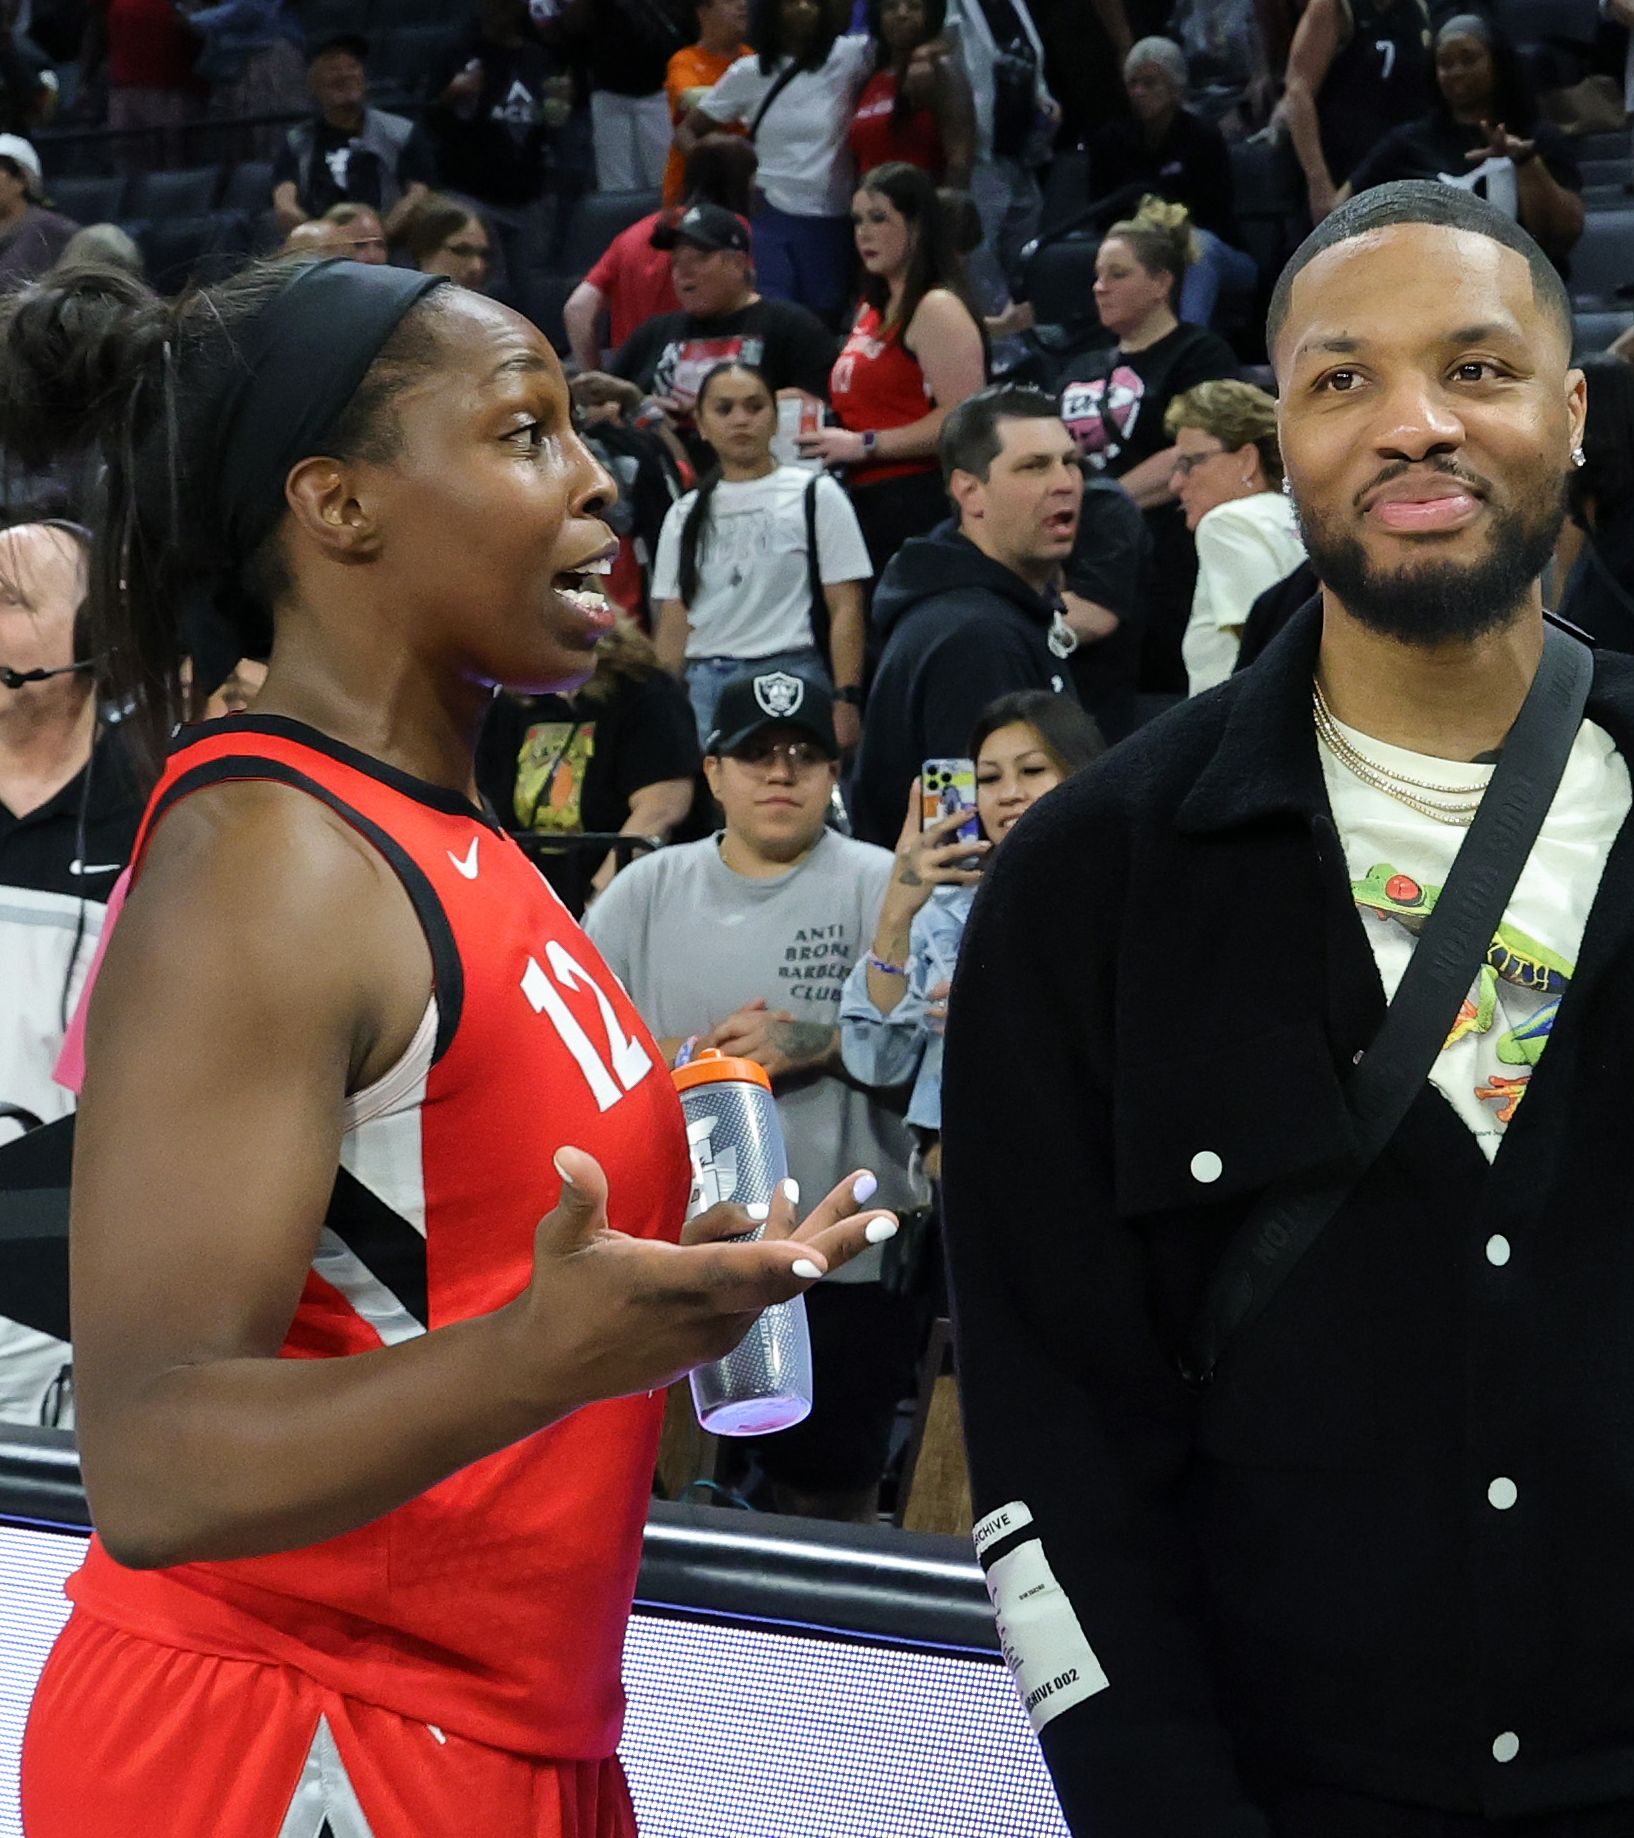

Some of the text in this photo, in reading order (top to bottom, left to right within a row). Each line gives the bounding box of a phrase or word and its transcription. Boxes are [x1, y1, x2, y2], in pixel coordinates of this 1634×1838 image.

[1375, 40, 1396, 79] 7
[795, 925, 844, 940] ANTI
[519, 939, 655, 1113] 12
[758, 1317, 776, 1377] INSULATED
[1053, 1668, 1081, 1690] 002
